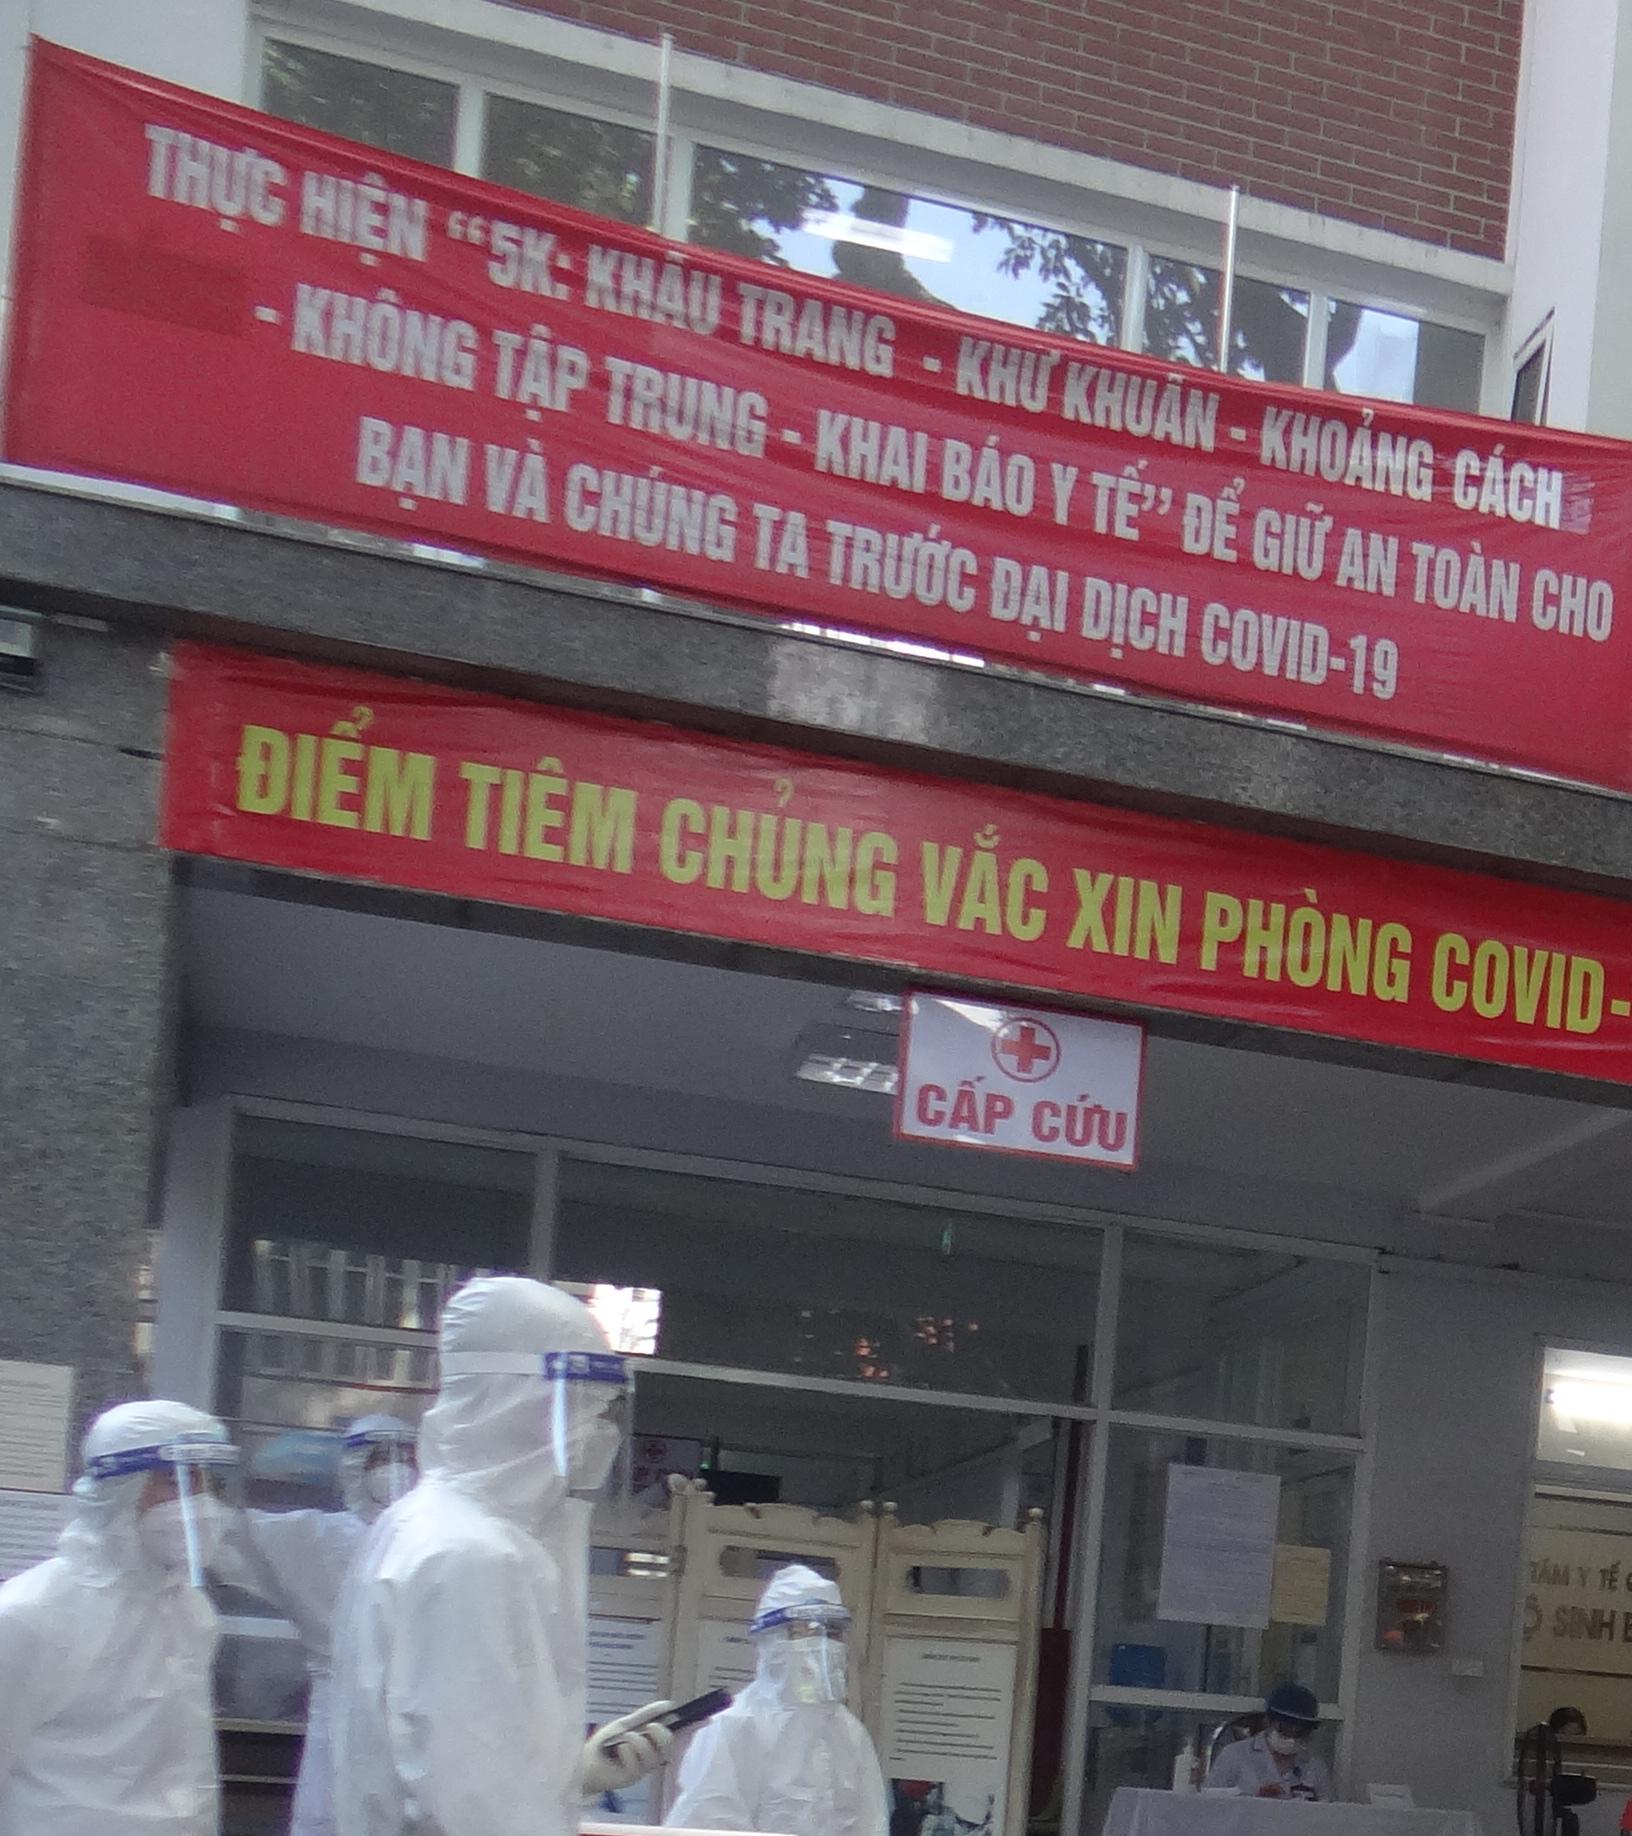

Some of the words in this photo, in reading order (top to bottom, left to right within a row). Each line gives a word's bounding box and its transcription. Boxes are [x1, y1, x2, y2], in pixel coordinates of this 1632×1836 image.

[144, 122, 287, 233] THỰC
[299, 171, 428, 266] HIỆN
[737, 281, 897, 378] TRANG
[1258, 407, 1434, 502] KHOẢNG
[1454, 444, 1564, 529] CÁCH
[292, 284, 477, 391] KHÔNG
[493, 328, 588, 421] TẬP
[605, 356, 767, 459] TRUNG
[815, 409, 927, 493] KHAI
[943, 434, 1035, 517] BÁO
[1051, 459, 1077, 526] Y
[1182, 476, 1248, 562] ĐỂ
[1253, 501, 1336, 580] GIỮ
[1338, 527, 1400, 597] AN
[1412, 540, 1520, 624] TOÀN
[1531, 575, 1614, 643] CHO
[356, 417, 469, 512] BẠN
[485, 438, 551, 523] VÀ
[565, 463, 737, 562] CHÚNG
[753, 503, 808, 579] TA
[825, 520, 977, 614] TRƯỚC
[991, 568, 1068, 643] ĐẠI
[1081, 574, 1189, 661] DỊCH
[1201, 602, 1400, 701] COVID-19
[236, 706, 438, 841] ĐIỂM
[460, 757, 637, 874] TIÊM
[660, 779, 897, 918] CHỦNG
[921, 824, 1047, 942] VẮC
[1066, 867, 1184, 966] XIN
[1201, 888, 1413, 1004] PHÒNG
[916, 1075, 1015, 1135] CẤP
[1032, 1093, 1128, 1151] CỨU
[1577, 1566, 1591, 1587] Y
[1600, 1560, 1621, 1591] TẾ
